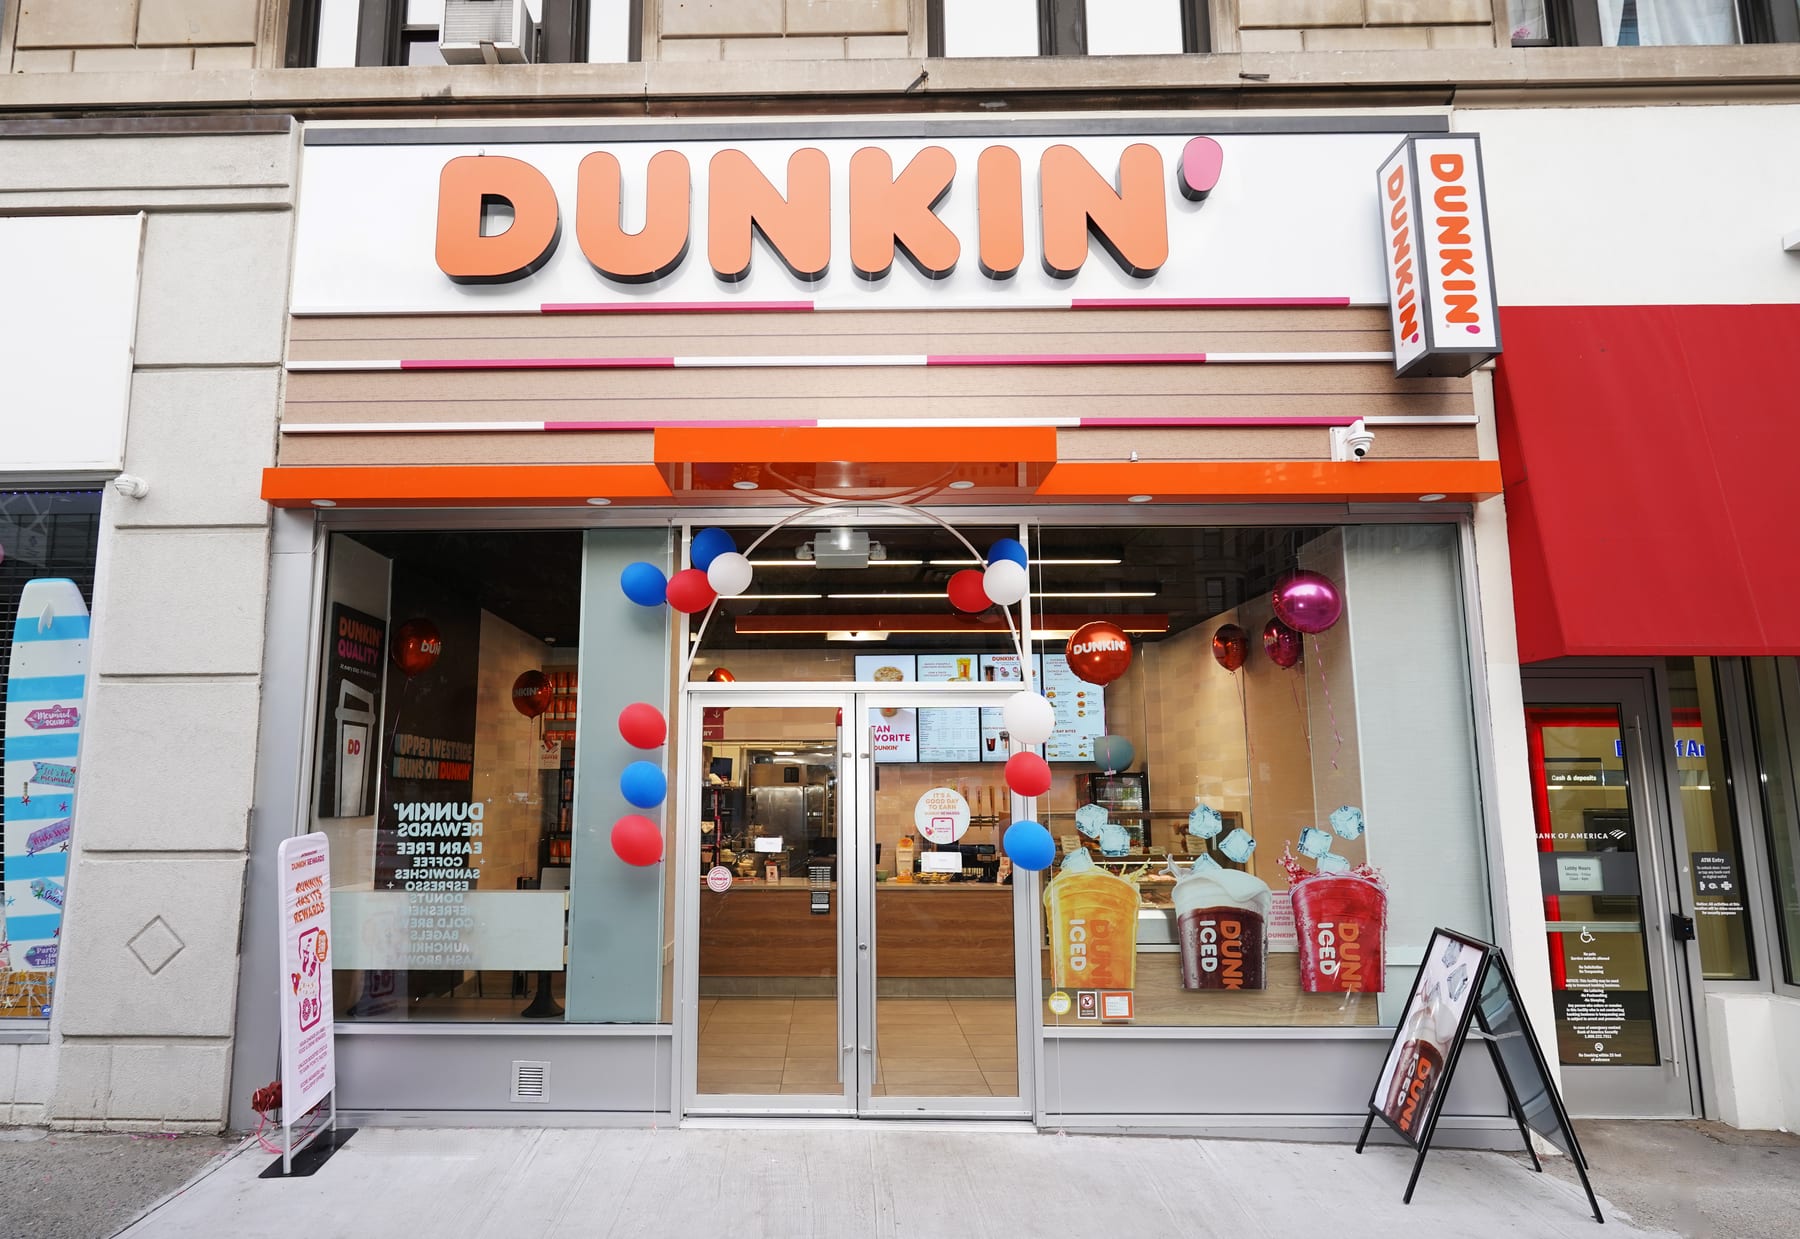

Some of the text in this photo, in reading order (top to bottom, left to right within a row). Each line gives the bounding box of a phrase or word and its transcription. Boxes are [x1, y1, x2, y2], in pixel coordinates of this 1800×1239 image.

[435, 136, 1223, 283] DUNKIN'
[1387, 164, 1419, 343] DUNKIN'
[1430, 154, 1480, 334] DUNKIN'
[338, 616, 383, 647] DUNKIN'
[337, 639, 379, 665] QUALITY
[1073, 640, 1127, 655] DUNKIN'
[347, 739, 360, 755] DD
[400, 734, 431, 757] UPPER
[400, 758, 424, 779] RUNS
[425, 760, 440, 779] ON
[294, 902, 325, 924] REWARDS
[1069, 918, 1087, 972] ICED
[1200, 920, 1218, 972] ICED
[1318, 922, 1336, 975] ICED
